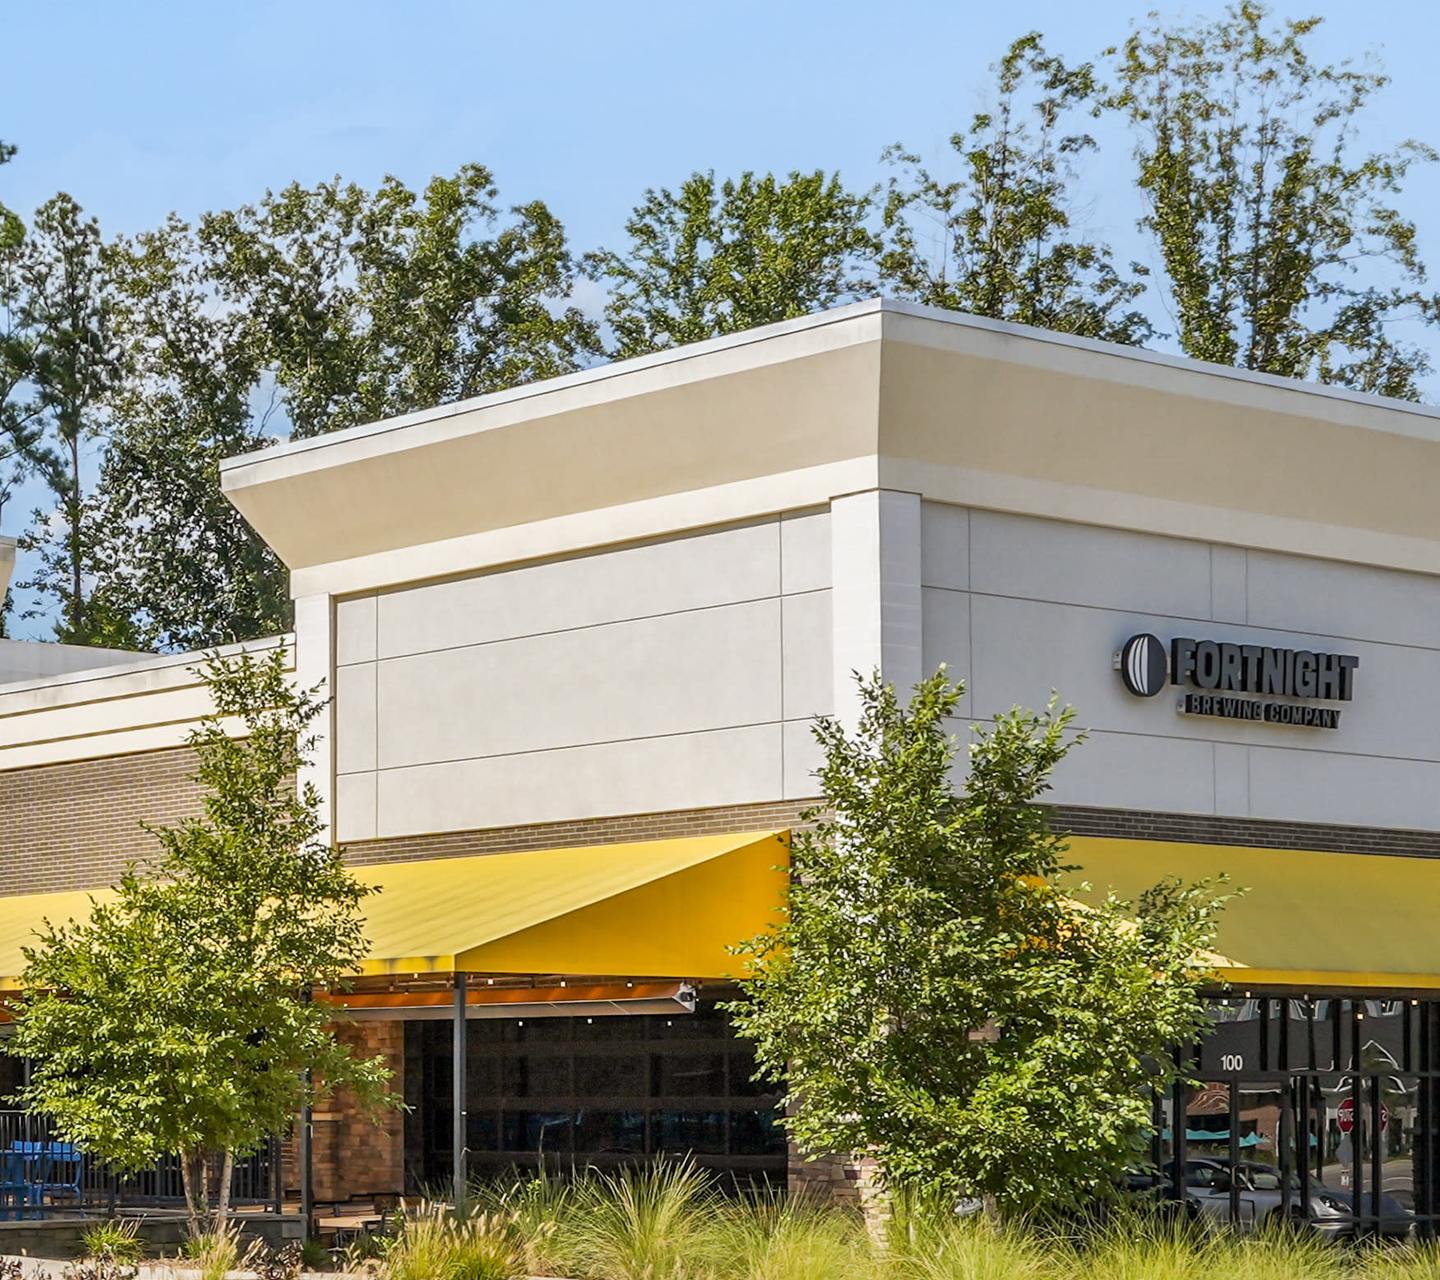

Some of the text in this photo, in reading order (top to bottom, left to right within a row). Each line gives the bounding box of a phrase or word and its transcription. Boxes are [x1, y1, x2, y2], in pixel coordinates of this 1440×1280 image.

[1171, 637, 1360, 701] FORTNIGHT
[1186, 694, 1342, 729] BREWING COMPANY
[1220, 1054, 1244, 1071] 100
